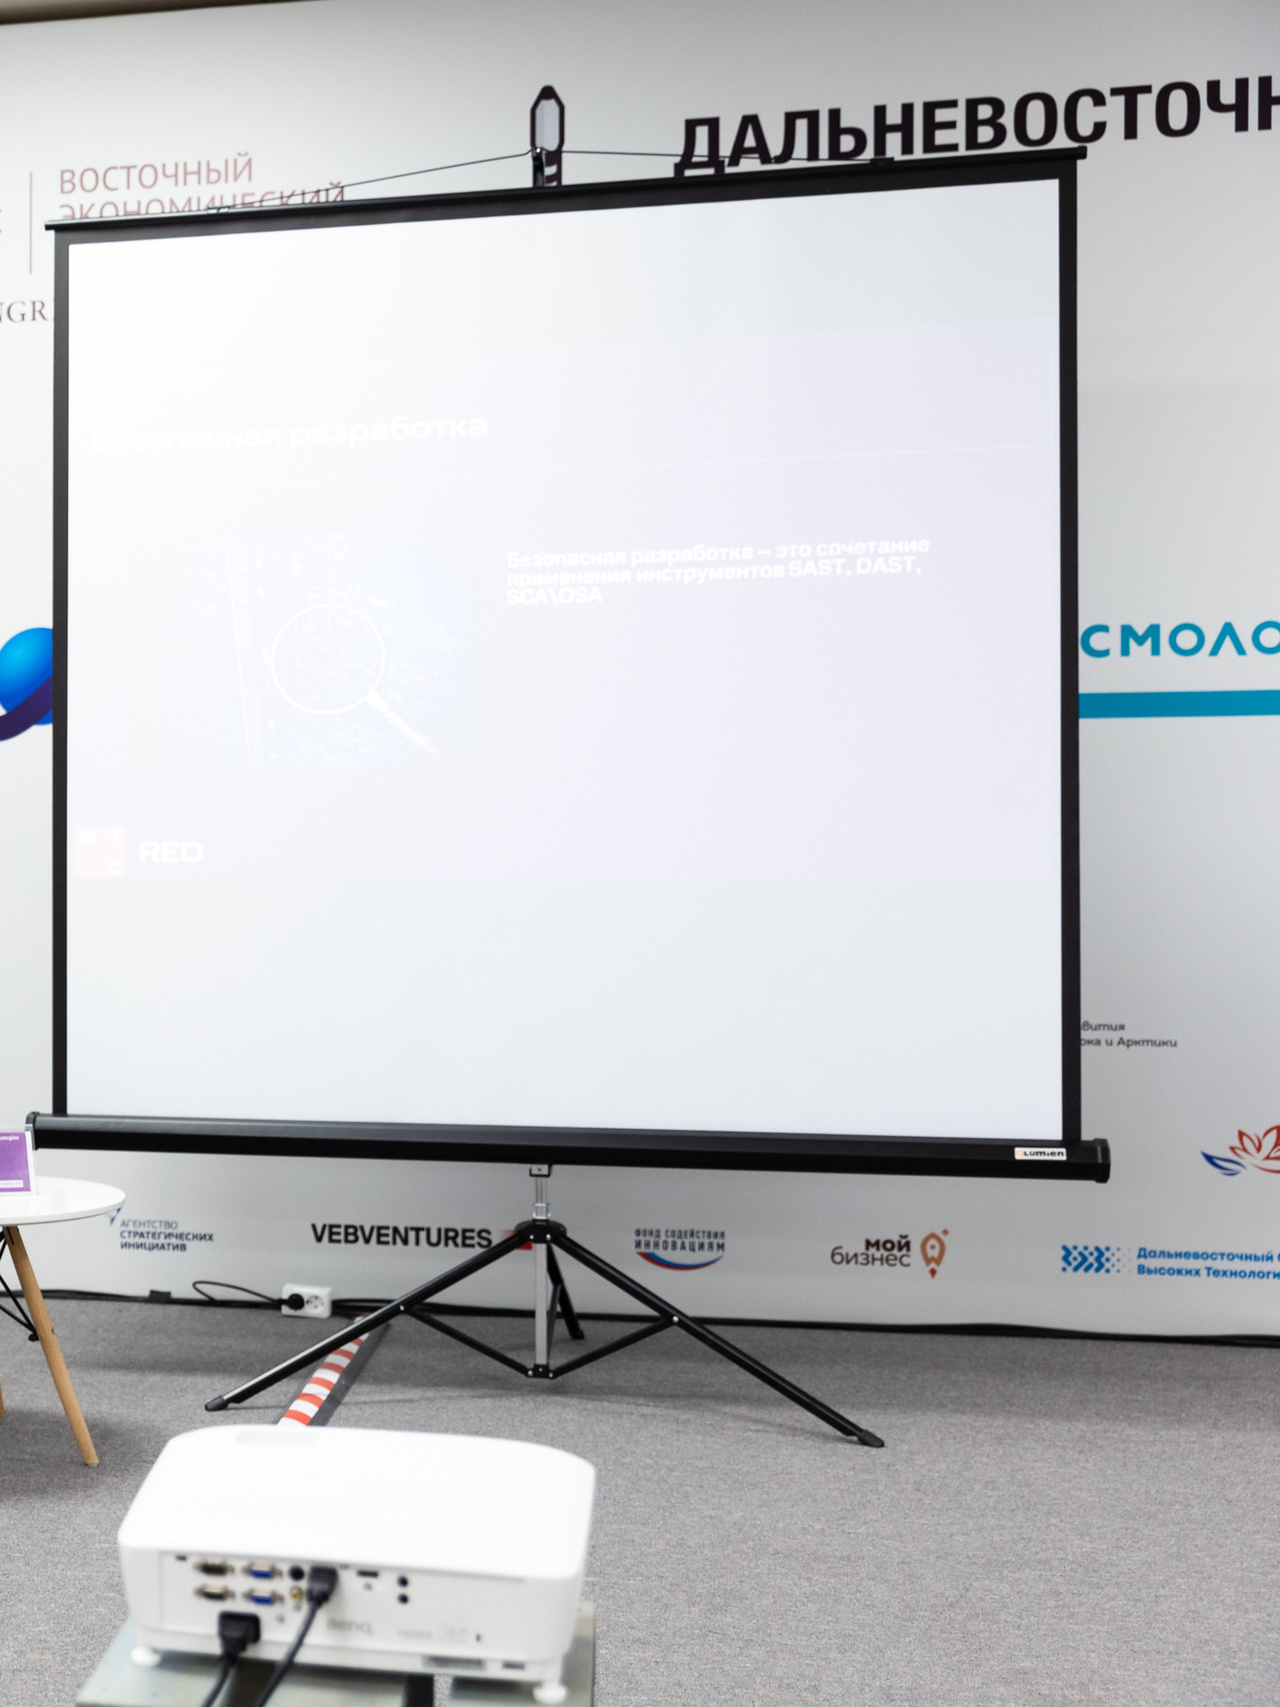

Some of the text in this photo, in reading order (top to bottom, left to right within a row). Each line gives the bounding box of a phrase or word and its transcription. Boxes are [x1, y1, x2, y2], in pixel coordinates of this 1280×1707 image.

[673, 75, 1280, 177] ДАЛЬНЕВОСТОЧН
[60, 151, 253, 194] ВОСТОЧНЫЙ
[89, 415, 489, 454] Безопасная разработка
[507, 550, 627, 568] Безопасная
[631, 543, 753, 567] разработка
[776, 543, 812, 558] это
[816, 538, 931, 557] сочетание
[507, 555, 923, 588] применения инструментов SAST, DAST,
[140, 841, 204, 863] RED
[1081, 1020, 1125, 1031] вития
[1105, 1038, 1114, 1047] и
[1116, 1037, 1178, 1050] Арктики
[120, 1219, 178, 1230] АГЕНТСТВО
[120, 1230, 214, 1242] СТРАТЕГИЧЕСКИХ
[311, 1223, 493, 1248] VEBVENTURES
[634, 1228, 726, 1240] ФОНД СОДЕЙСТВИЯ
[120, 1241, 187, 1252] ИНИЦИАТИВ
[634, 1239, 726, 1253] ИННОВАЦИЯМ
[1136, 1246, 1274, 1263] Дальневосточный
[830, 1245, 911, 1267] бизнес
[1136, 1263, 1280, 1280] Высоких Технологи
